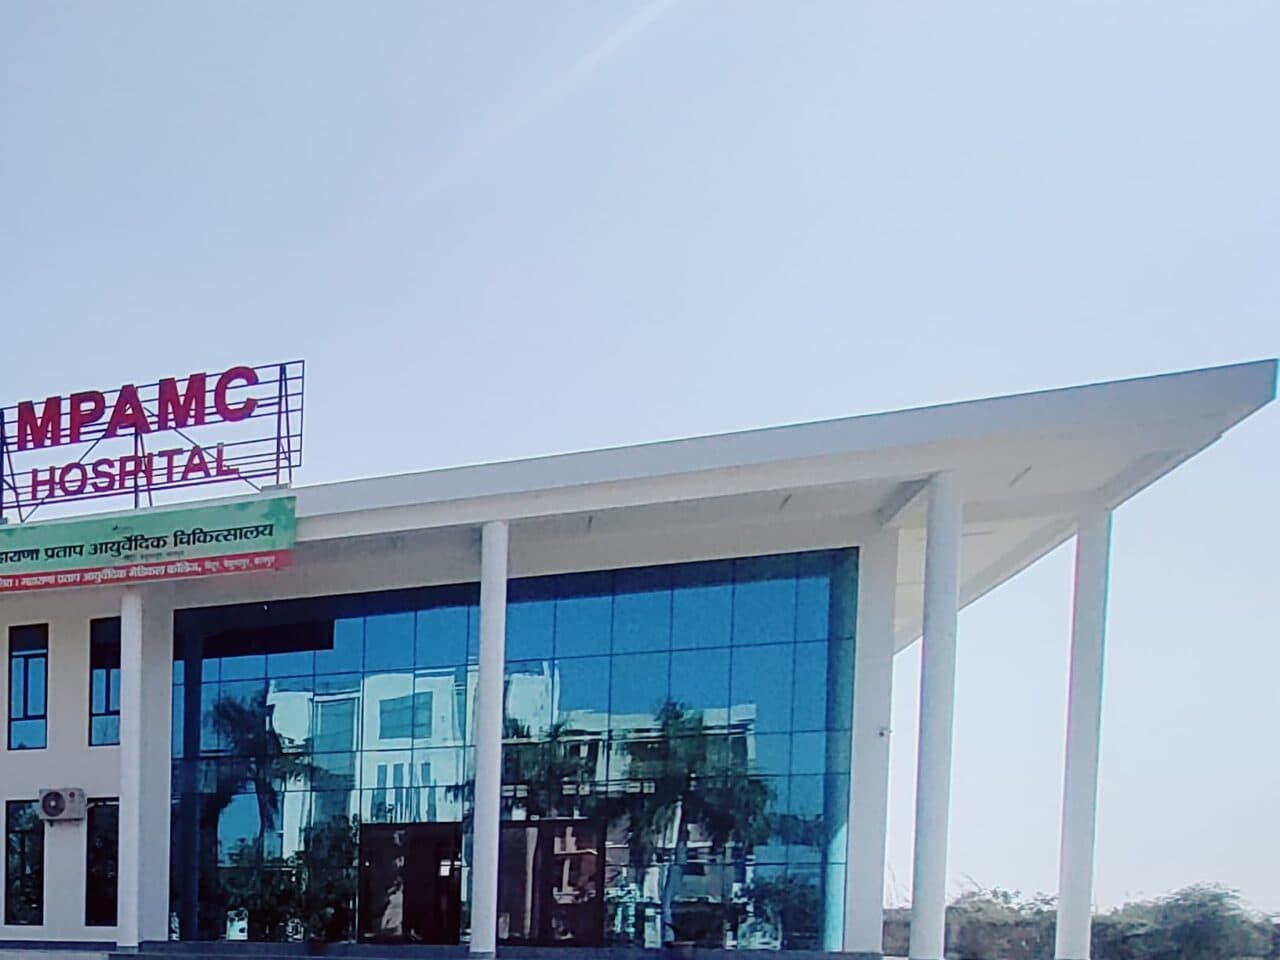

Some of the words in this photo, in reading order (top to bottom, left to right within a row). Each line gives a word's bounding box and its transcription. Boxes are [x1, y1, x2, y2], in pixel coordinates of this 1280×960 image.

[17, 366, 259, 450] MPAMC
[31, 442, 240, 500] HOSPITAL
[44, 544, 85, 561] प्रताप
[88, 534, 168, 558] आयुर्वेदिक
[173, 523, 274, 548] चिकित्सालय
